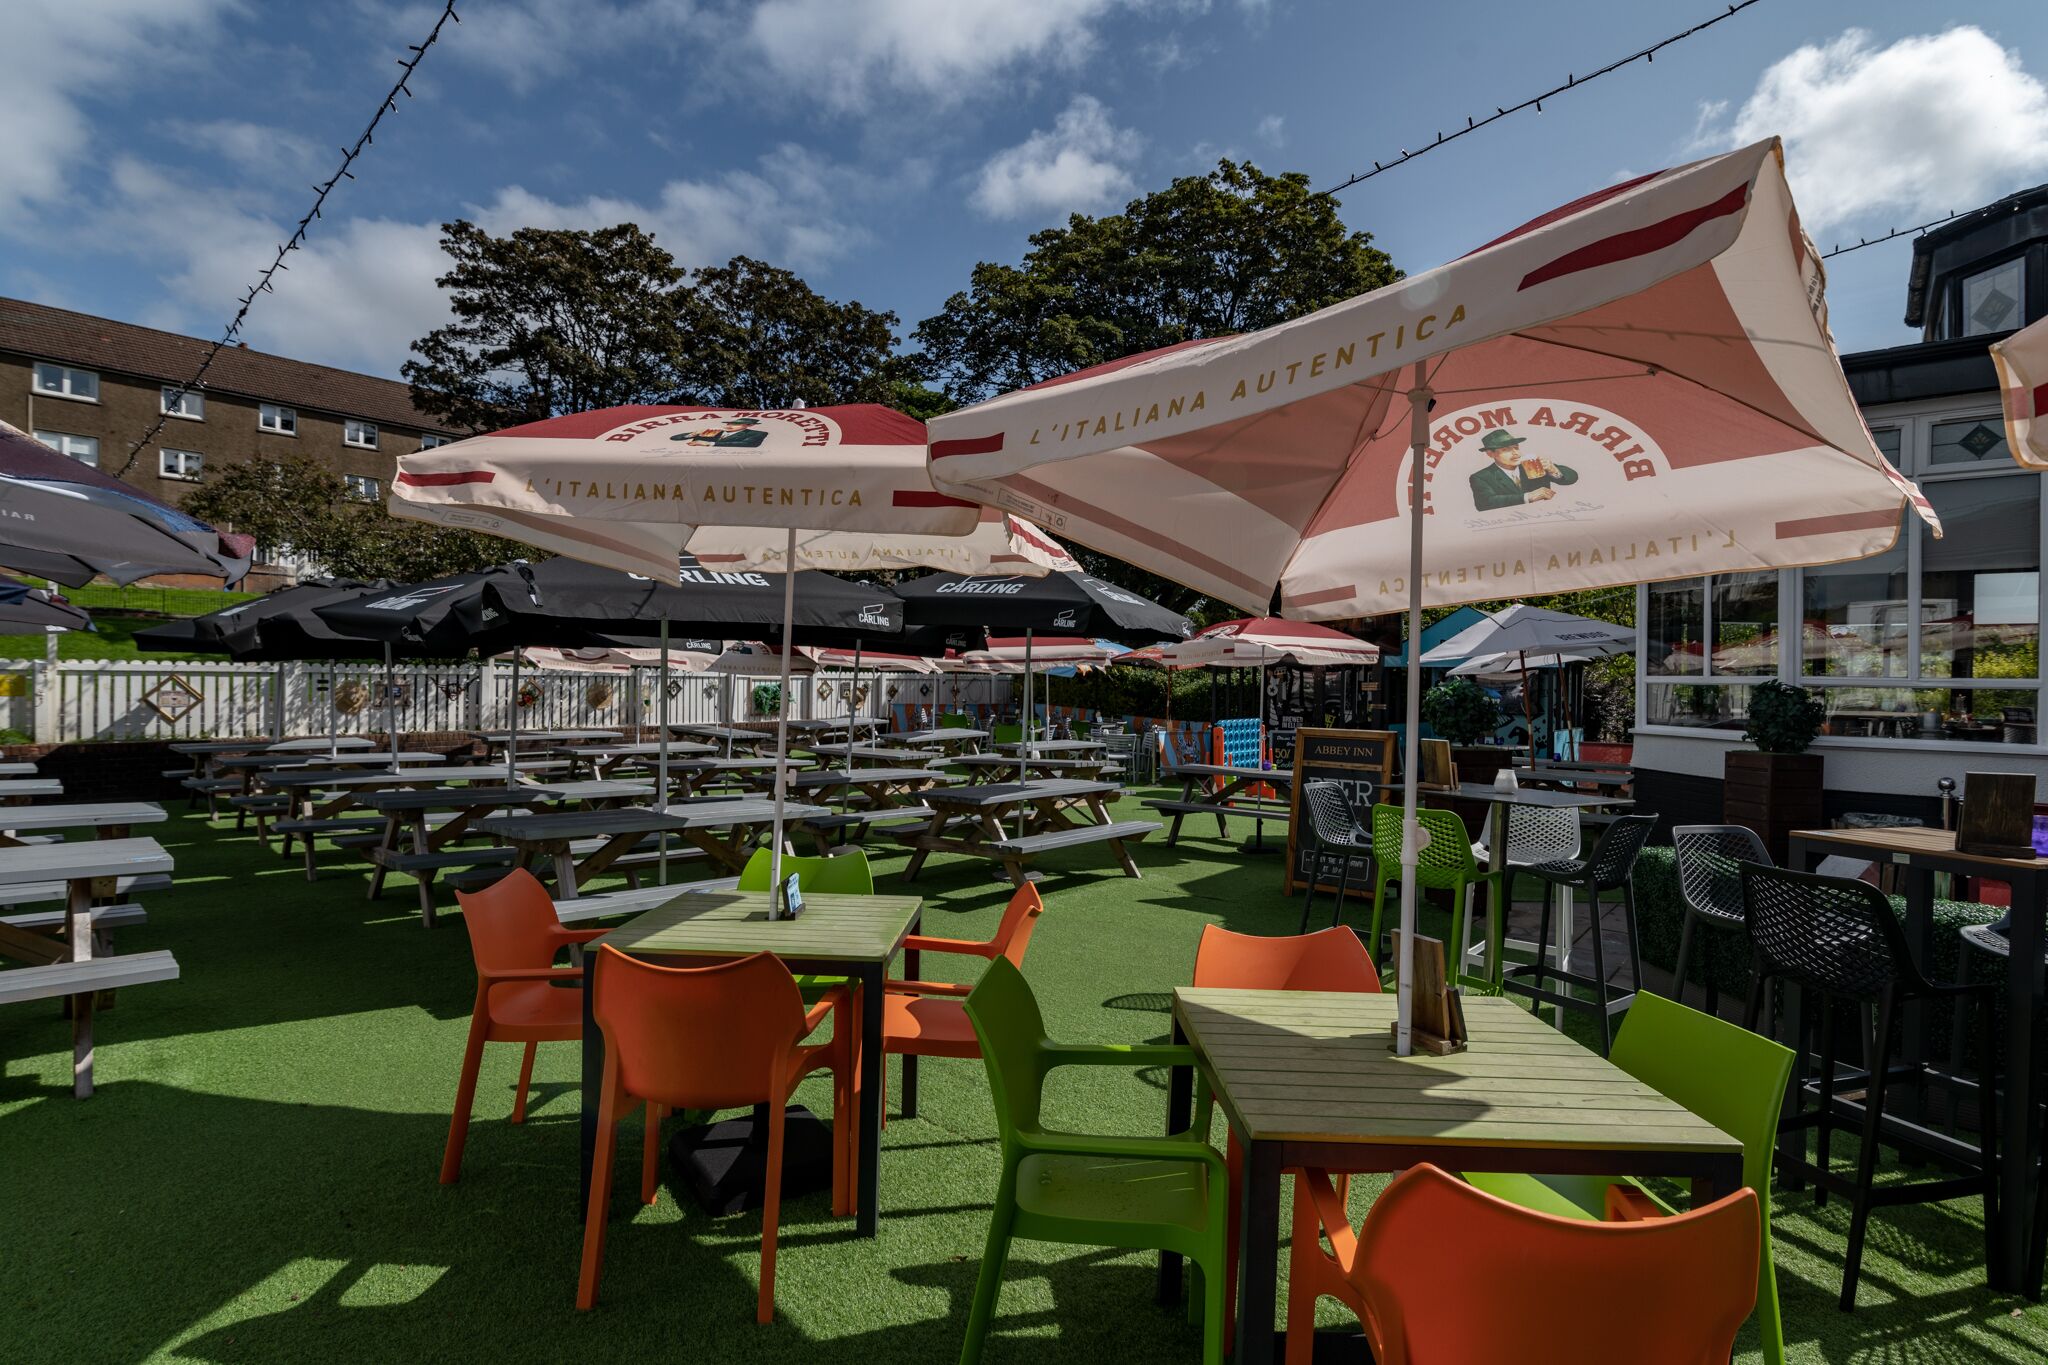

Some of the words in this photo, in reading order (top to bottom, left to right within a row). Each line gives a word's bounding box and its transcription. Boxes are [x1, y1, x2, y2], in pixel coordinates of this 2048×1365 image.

[1030, 391, 1206, 446] L'ITALIANA
[1230, 303, 1467, 402] AUTENTICA
[605, 412, 723, 443] BIRRA
[731, 411, 830, 447] MORETTI
[525, 477, 684, 501] L'ITALIANA
[703, 484, 862, 507] AUTENTICA
[627, 569, 771, 587] RLING
[935, 582, 1024, 594] CARLING
[858, 612, 890, 627] CARLING
[1053, 617, 1077, 628] CARLING
[685, 640, 712, 650] CARLING
[1314, 745, 1352, 756] ABBEY
[1353, 746, 1373, 757] INN
[1308, 776, 1374, 808] ER
